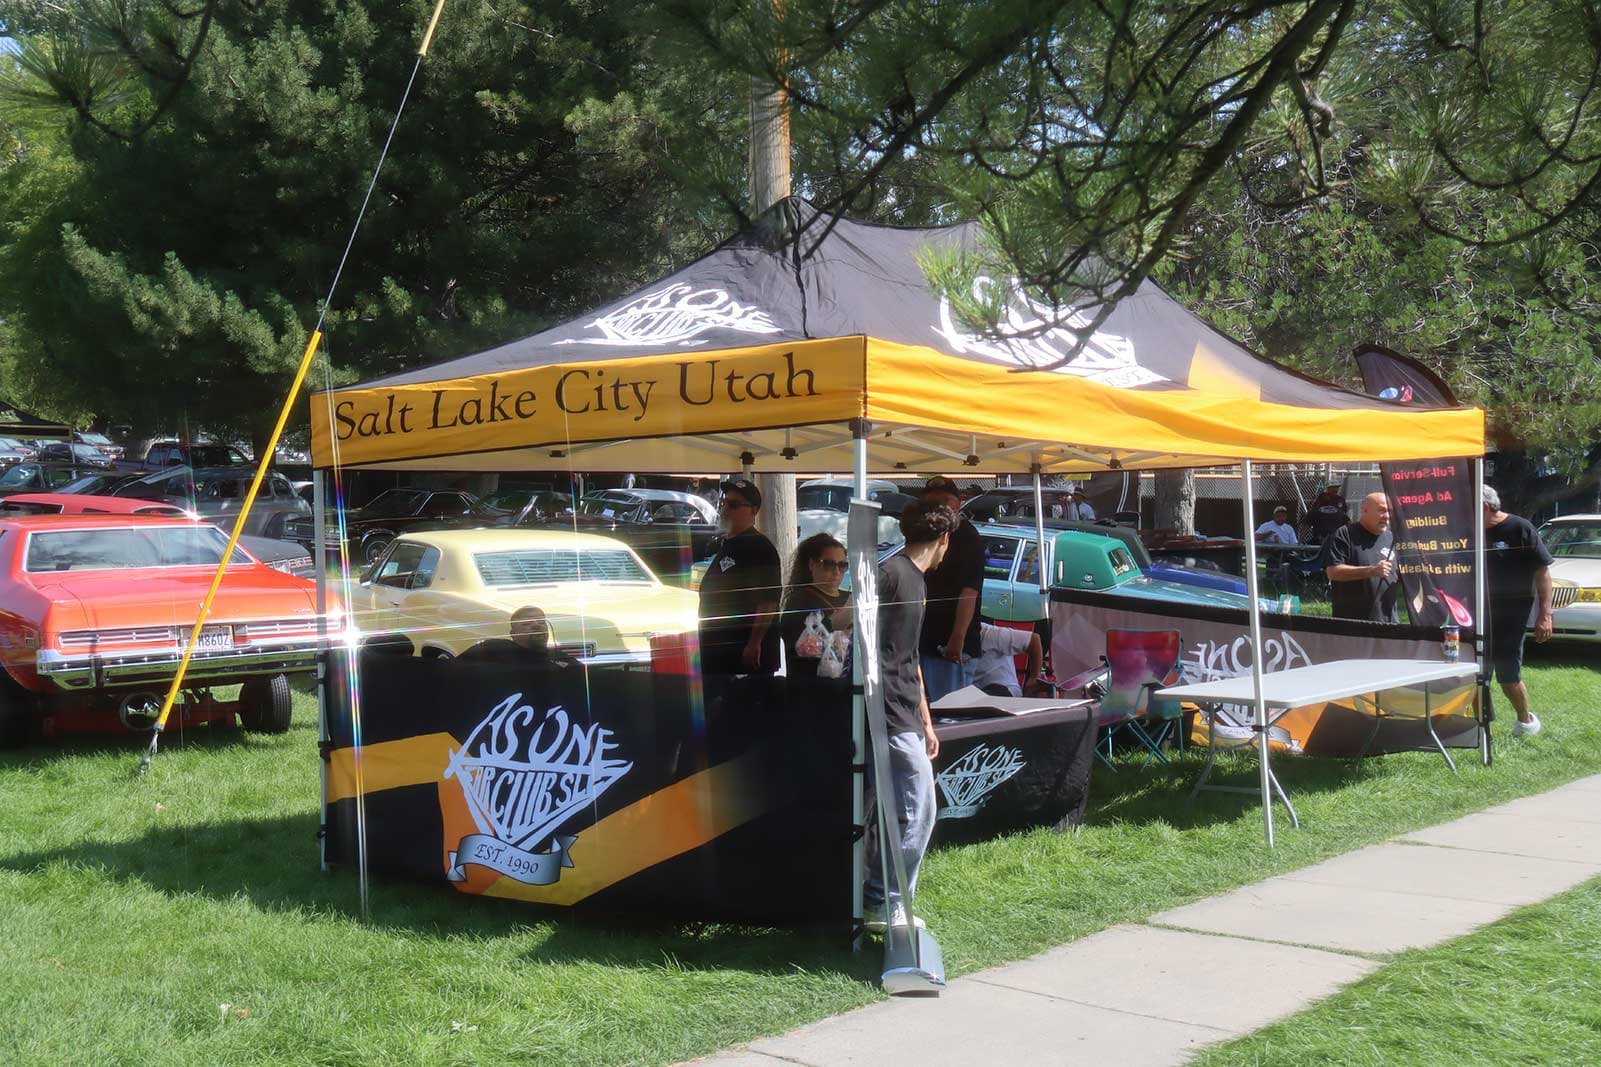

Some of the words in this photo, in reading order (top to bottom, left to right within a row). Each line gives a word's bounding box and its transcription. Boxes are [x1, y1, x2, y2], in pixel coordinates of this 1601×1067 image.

[334, 394, 414, 441] Salt
[427, 380, 537, 430] Lake
[555, 369, 657, 422] City
[676, 351, 822, 406] Utah
[458, 692, 535, 762] AS
[528, 704, 630, 768] ONE
[507, 855, 539, 875] 1990
